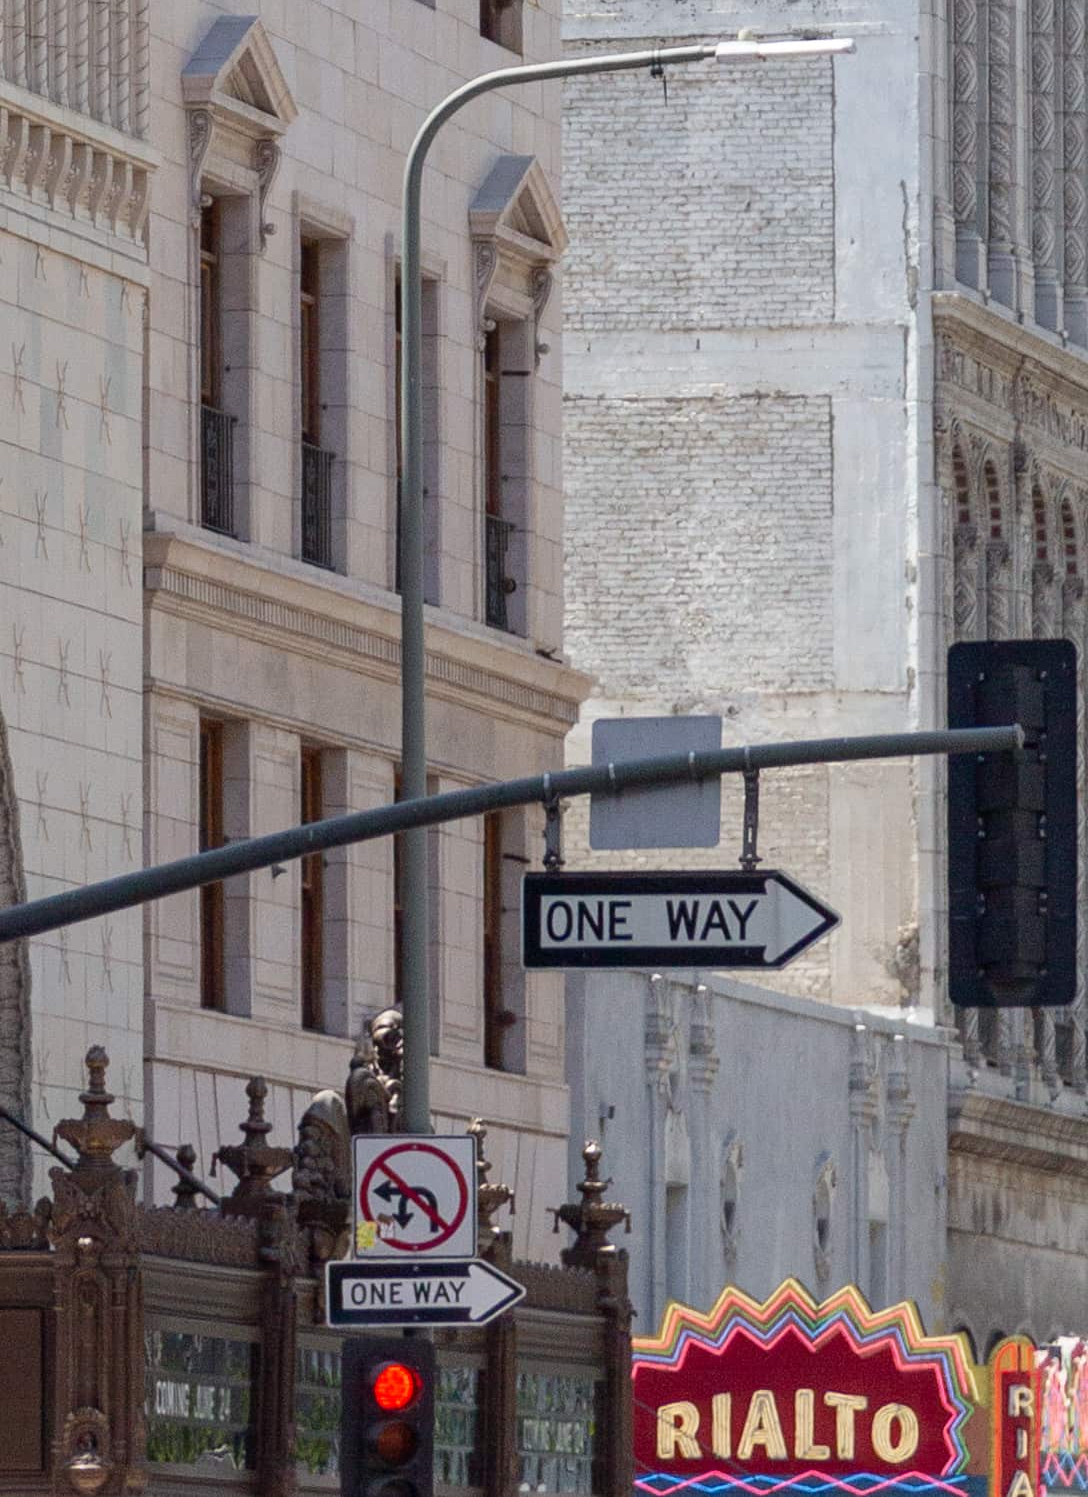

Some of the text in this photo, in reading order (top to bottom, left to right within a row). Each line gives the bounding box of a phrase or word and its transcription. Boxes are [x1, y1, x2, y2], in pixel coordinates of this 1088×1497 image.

[546, 899, 759, 942] ONE WAY
[350, 1281, 465, 1306] ONE WAY
[656, 1389, 920, 1464] RIALTO
